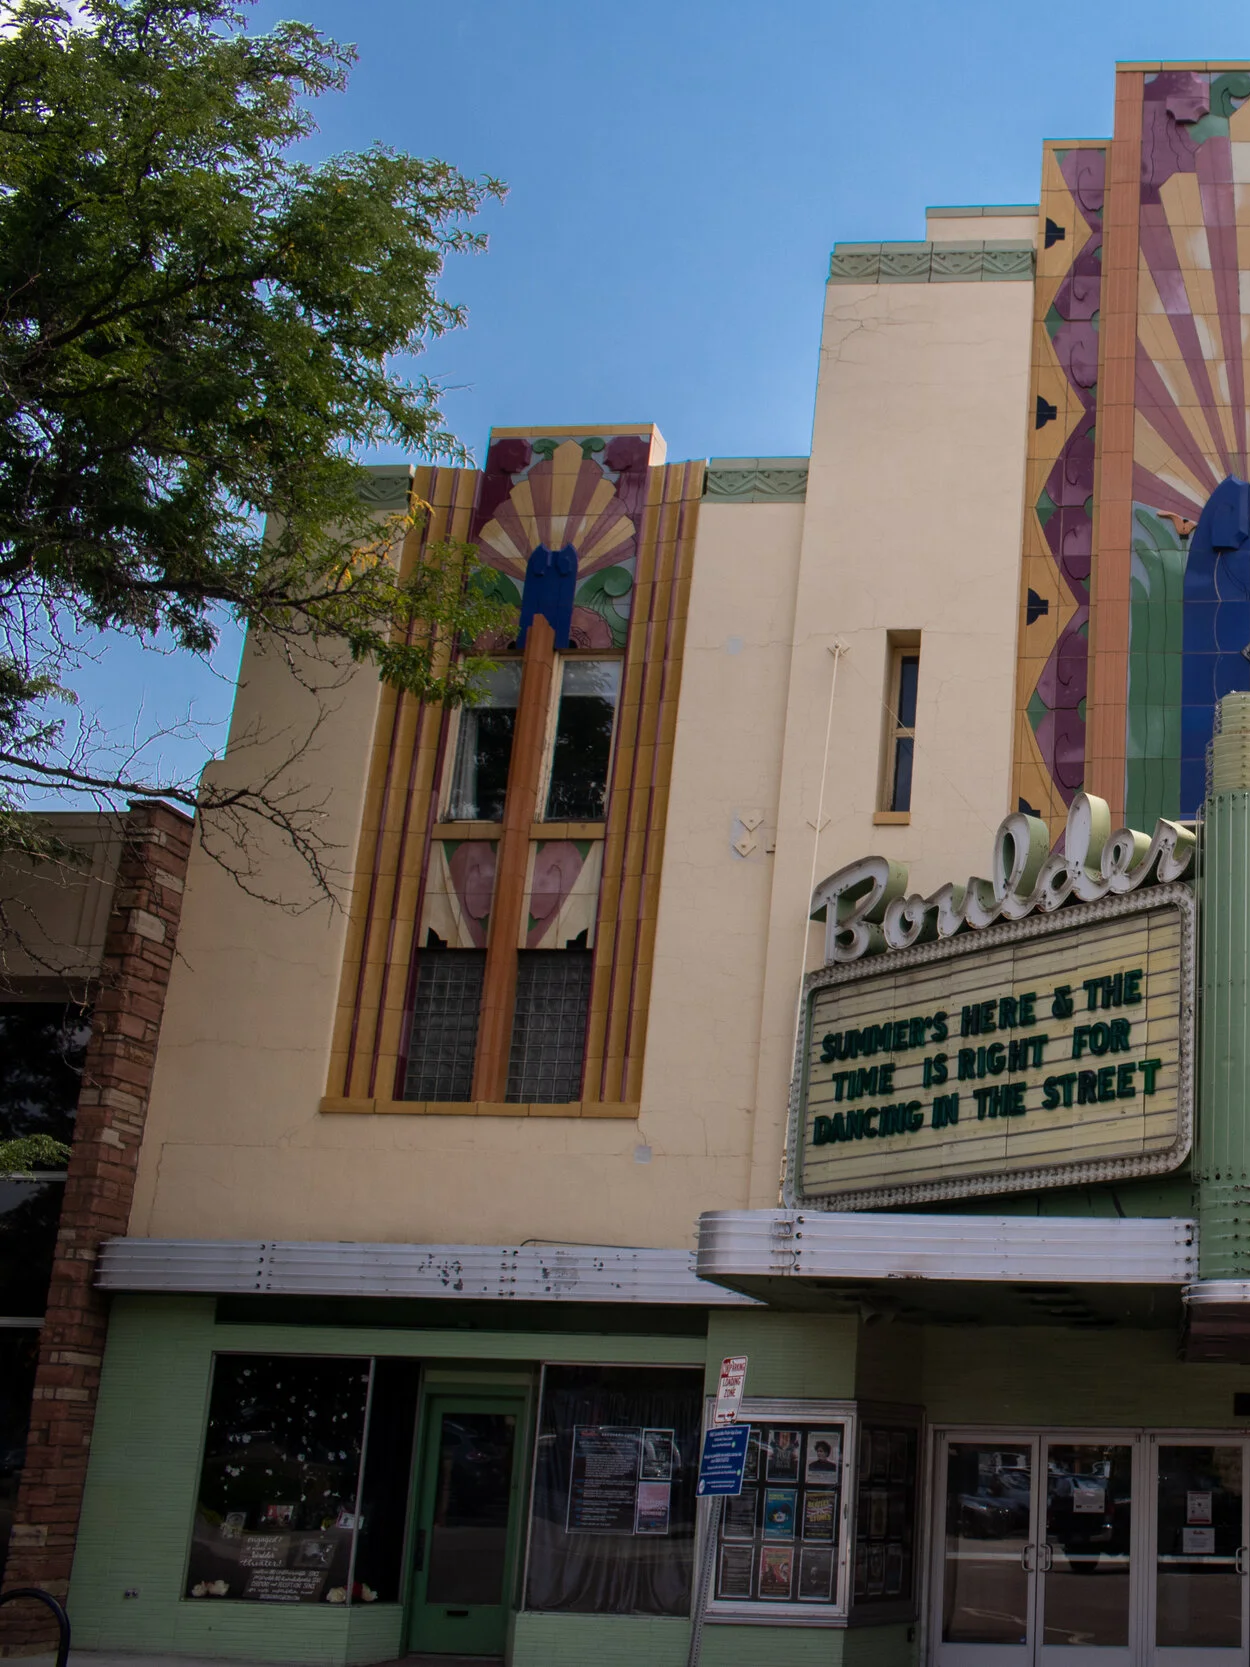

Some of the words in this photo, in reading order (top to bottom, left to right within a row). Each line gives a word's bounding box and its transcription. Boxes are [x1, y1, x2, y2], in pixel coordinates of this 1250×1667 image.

[811, 792, 1197, 967] Boulder
[819, 1011, 949, 1064] SUMMER'S
[960, 992, 1037, 1037] HERE
[1051, 985, 1074, 1020] &
[1082, 968, 1143, 1012] THE
[812, 1100, 924, 1145] DANCING
[931, 1092, 959, 1129] IN
[973, 1082, 1027, 1121] THE
[1042, 1057, 1162, 1110] STREET
[832, 1062, 896, 1102] TIME
[922, 1052, 948, 1088] IS
[958, 1034, 1049, 1081] RIGHT
[1071, 1017, 1131, 1060] FOR
[722, 1377, 742, 1387] LOADING
[724, 1388, 737, 1398] ZONE
